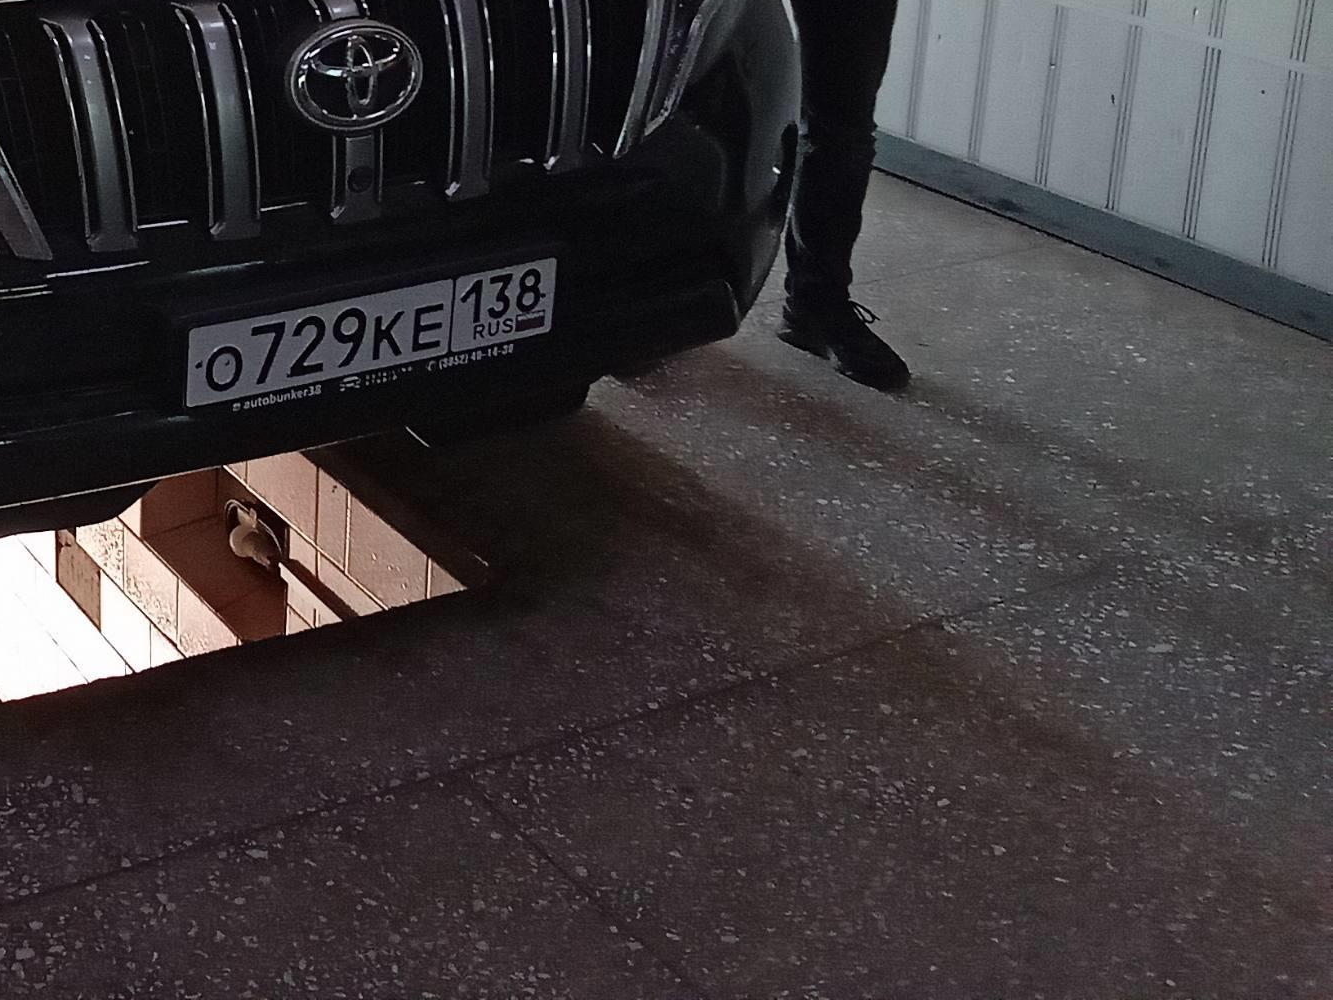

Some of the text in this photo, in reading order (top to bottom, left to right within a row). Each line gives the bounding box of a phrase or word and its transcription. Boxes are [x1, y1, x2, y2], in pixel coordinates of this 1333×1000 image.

[205, 268, 541, 392] О729КЕ 138
[473, 318, 514, 340] RUS
[243, 384, 322, 410] autobunker38
